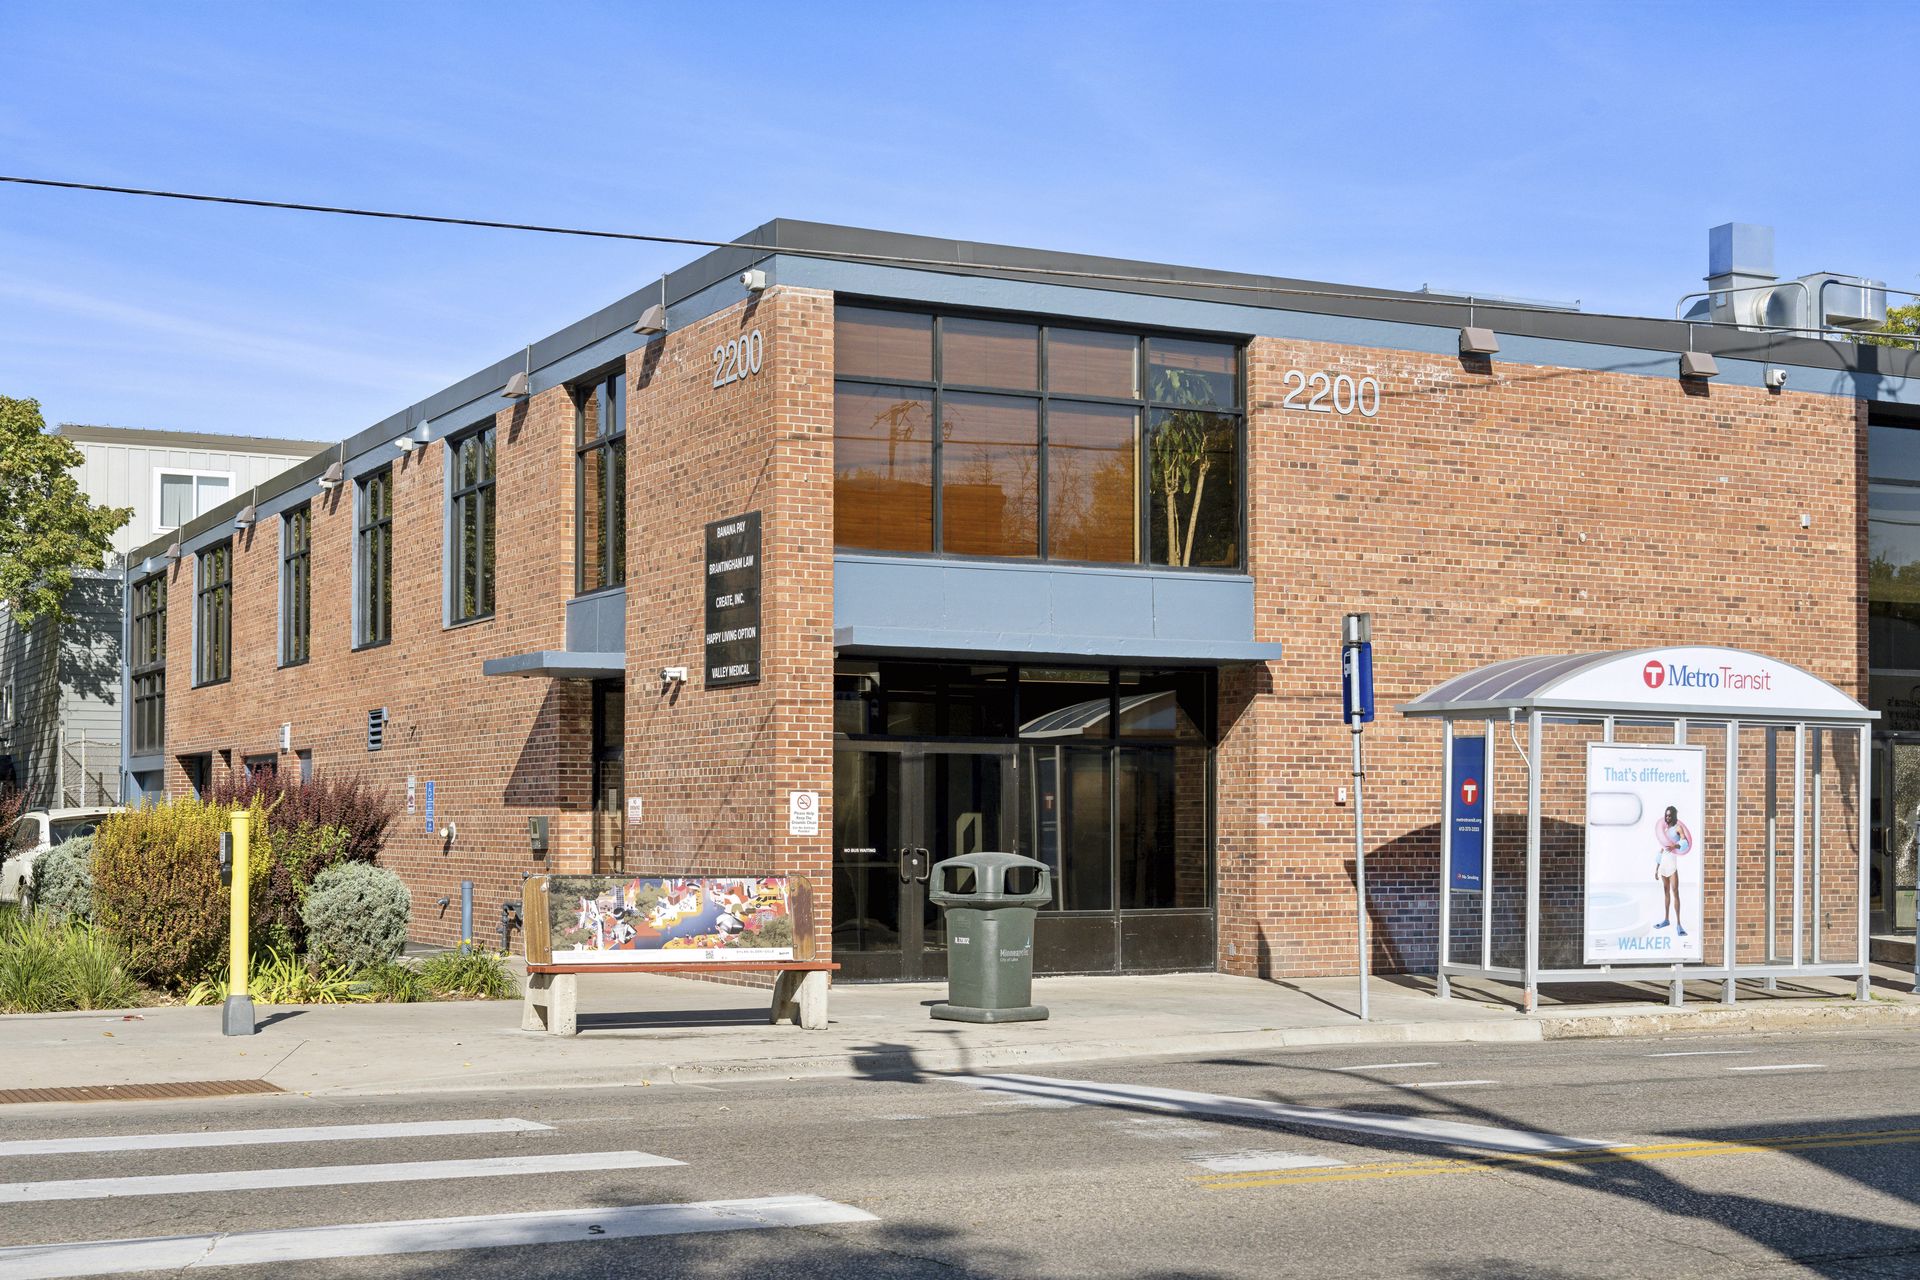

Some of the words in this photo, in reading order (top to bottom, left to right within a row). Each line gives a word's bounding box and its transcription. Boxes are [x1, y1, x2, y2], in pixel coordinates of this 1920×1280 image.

[713, 329, 763, 389] 2200
[1283, 369, 1380, 417] 2200
[716, 524, 736, 538] BANANA
[736, 521, 746, 534] PAY
[709, 558, 742, 575] BRANTINGHAM
[743, 555, 754, 568] LAW
[716, 595, 734, 608] CREATE,
[734, 592, 745, 605] INC.
[706, 631, 721, 645] HAPPY
[721, 629, 738, 643] LIVING
[737, 626, 757, 640] OPTION
[711, 665, 729, 679] VALLEY
[728, 663, 750, 677] MEDICAL
[1603, 766, 1638, 783] That's
[1639, 767, 1690, 784] different.
[1617, 936, 1671, 951] WALKER
